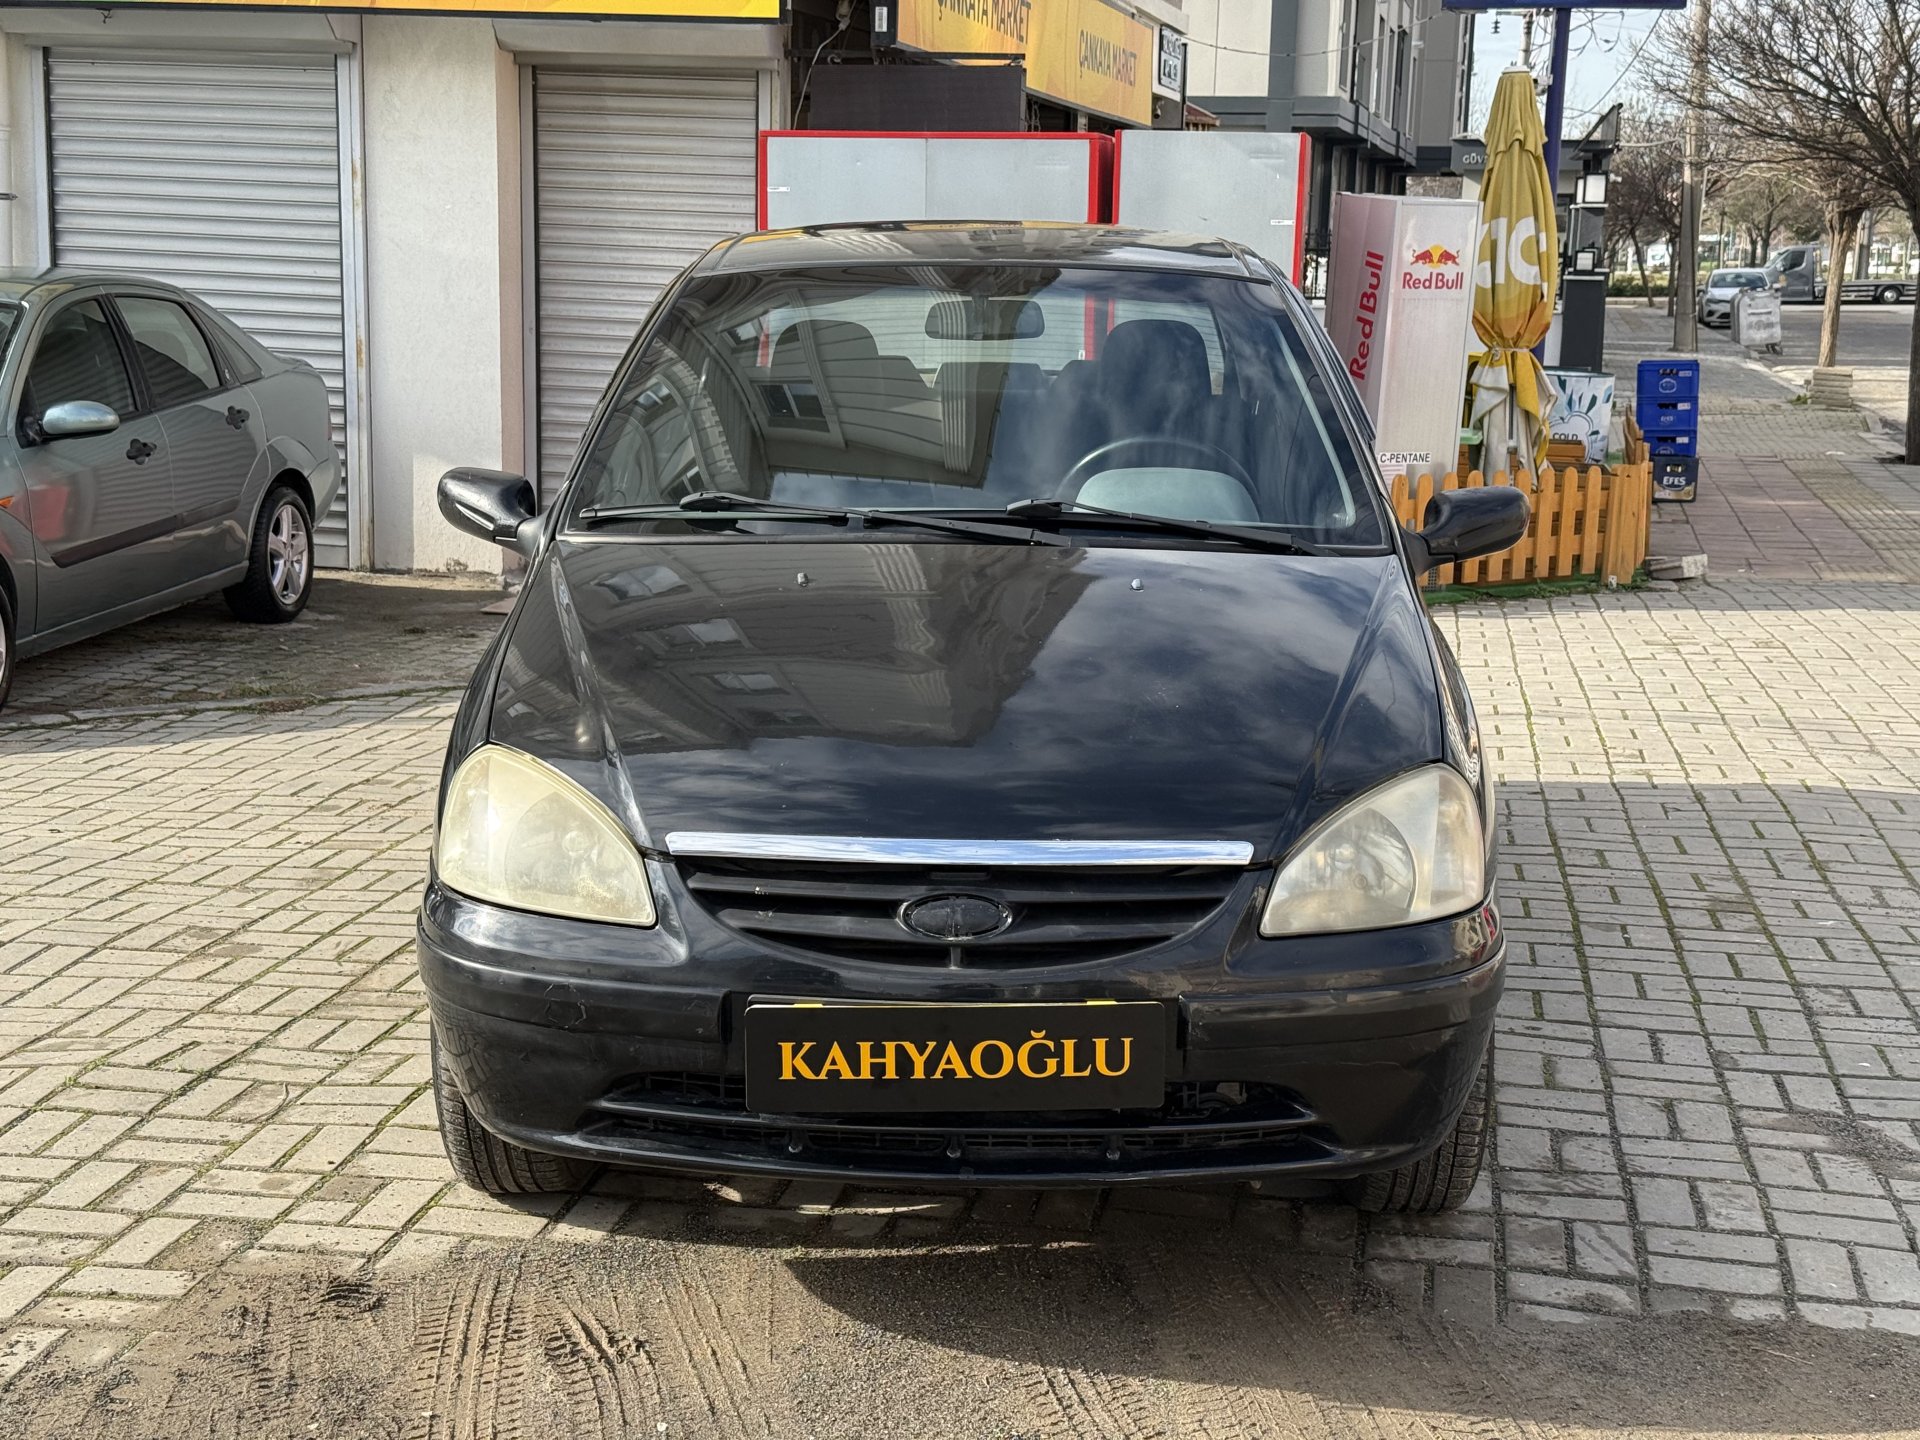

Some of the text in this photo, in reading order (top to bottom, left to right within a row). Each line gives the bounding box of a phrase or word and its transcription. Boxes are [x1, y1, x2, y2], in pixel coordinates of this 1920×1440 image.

[1079, 29, 1110, 79] ÇANKAYA
[1112, 43, 1136, 87] MARKET
[1402, 271, 1464, 290] Red Bull
[1349, 250, 1384, 380] Red Bull
[1380, 452, 1431, 463] C-PENTANE
[1662, 476, 1687, 486] EFES
[777, 1029, 1134, 1080] KAHYAOĞLU
